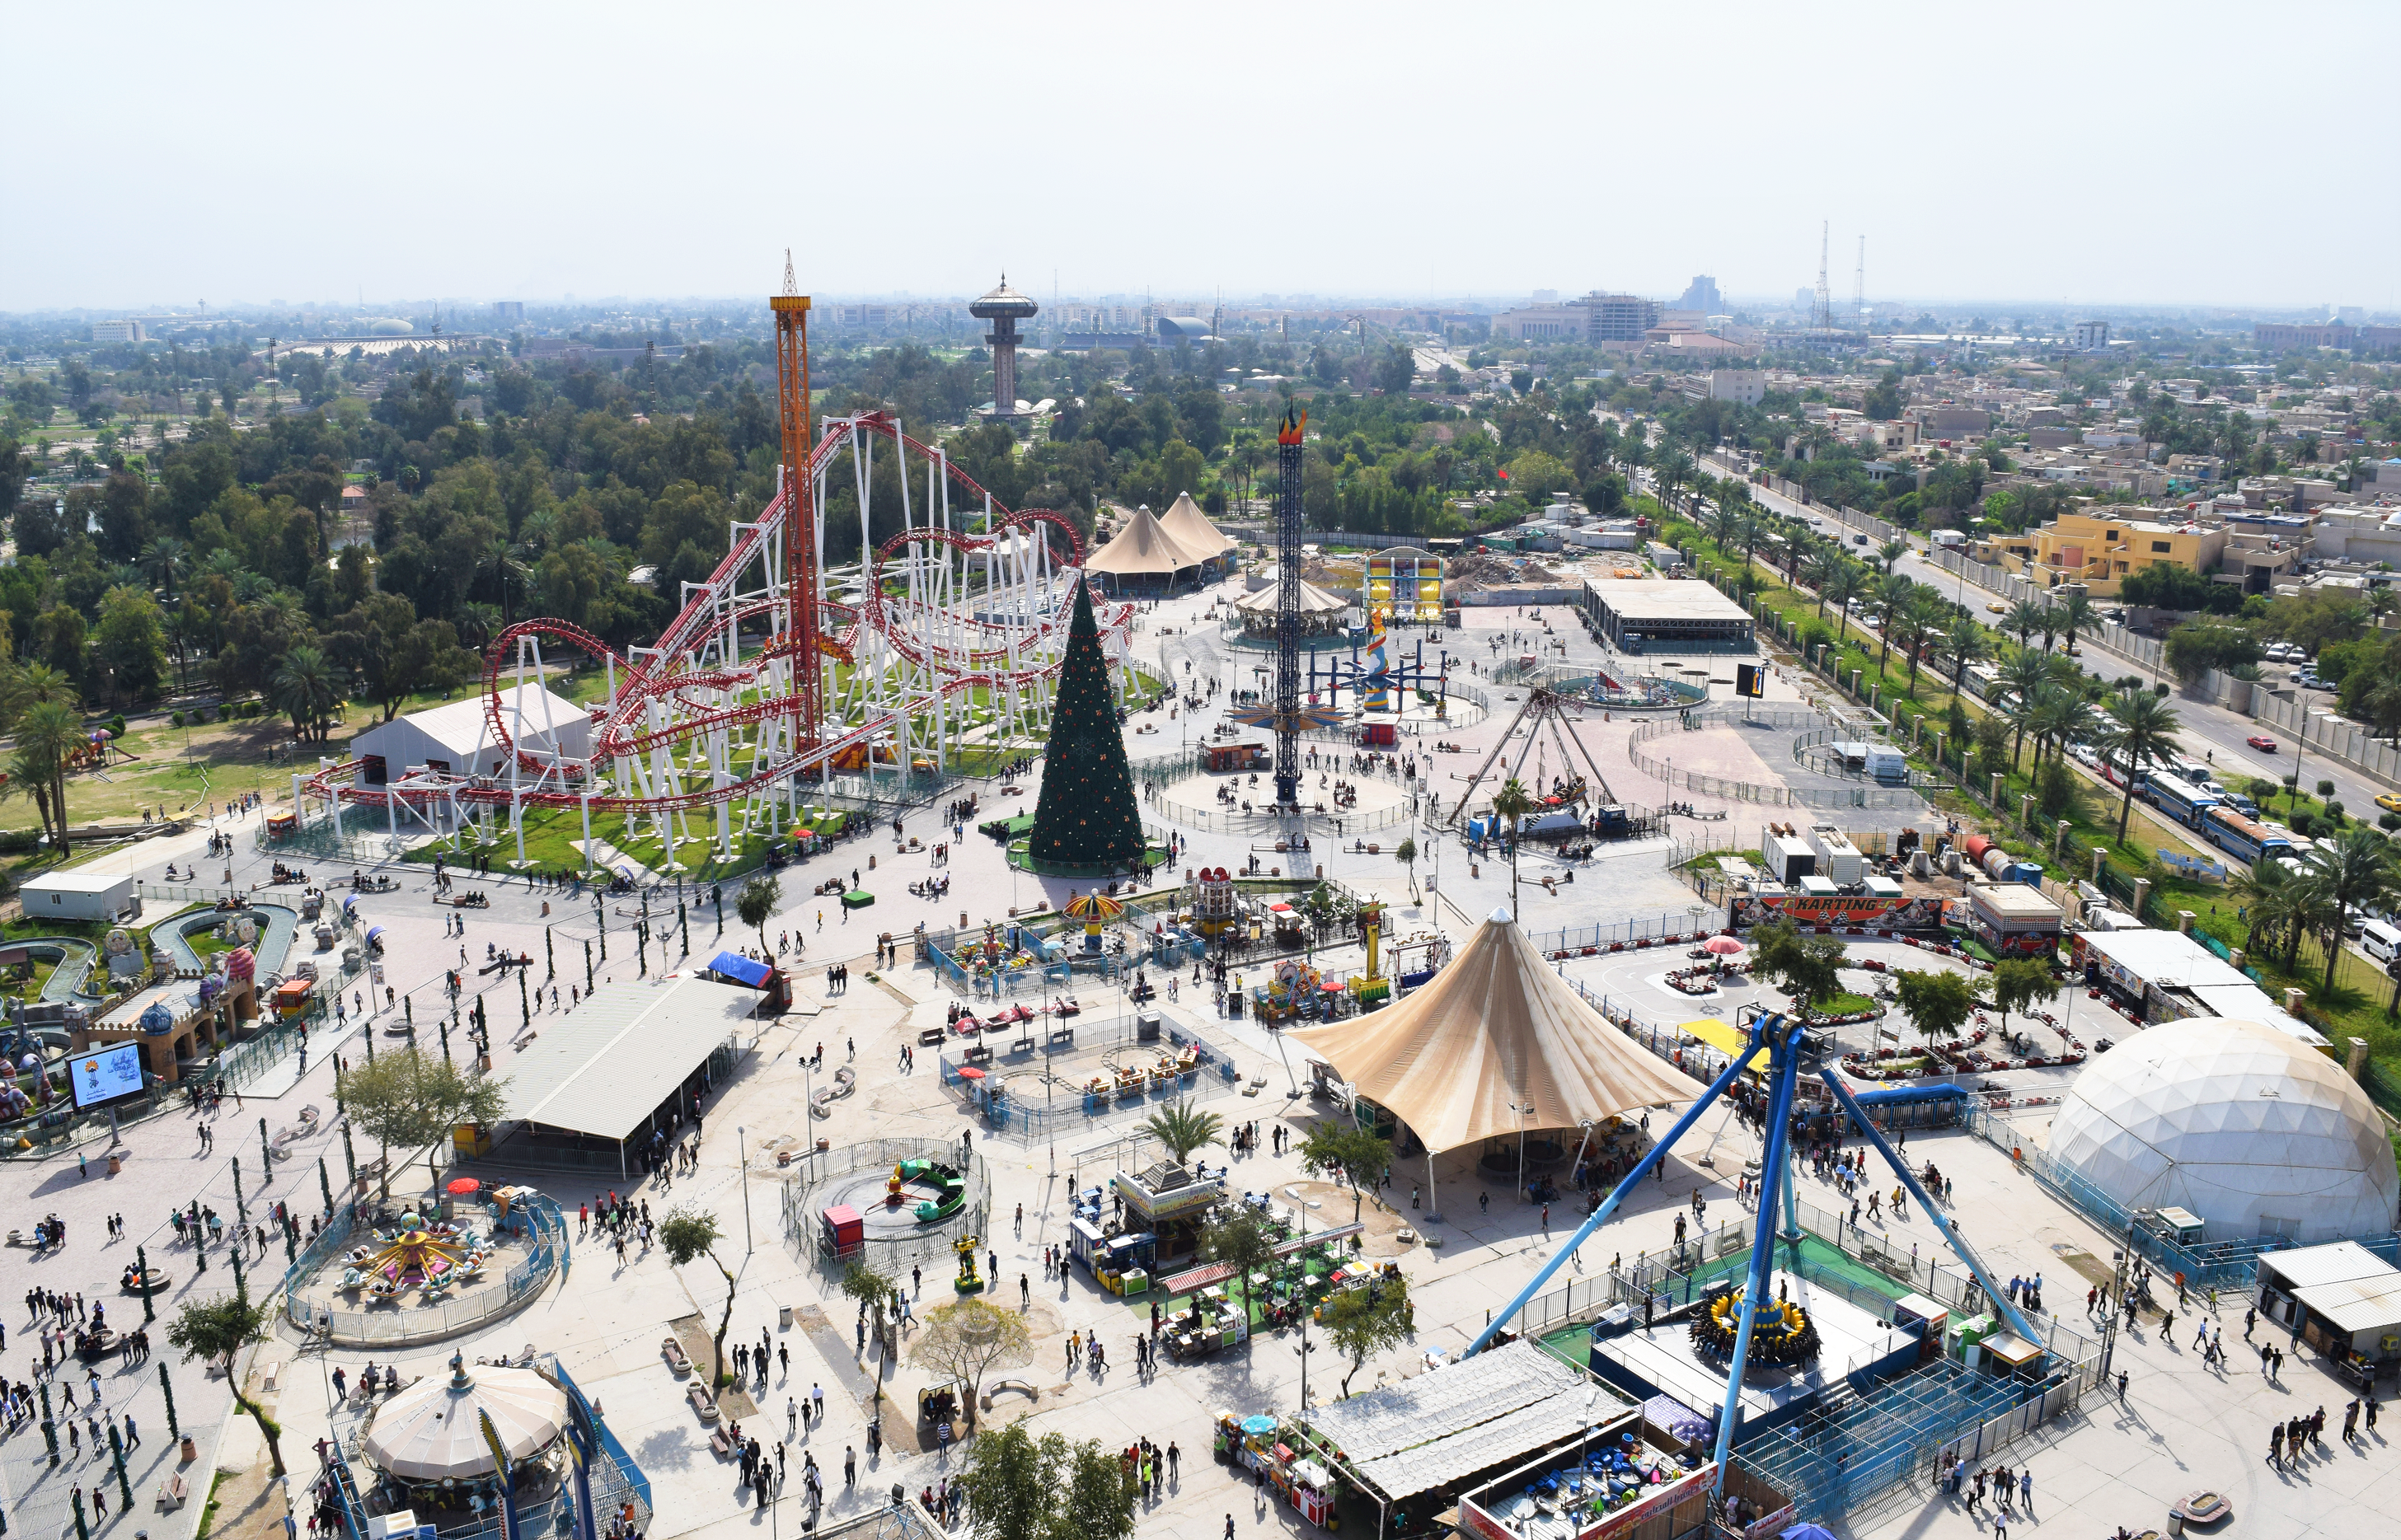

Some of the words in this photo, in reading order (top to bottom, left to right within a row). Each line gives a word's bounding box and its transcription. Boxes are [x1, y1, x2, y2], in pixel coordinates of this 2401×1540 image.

[1525, 693, 1587, 719] GALLEON
[1795, 898, 1878, 910] KARTING
[1188, 1193, 1209, 1205] Mila
